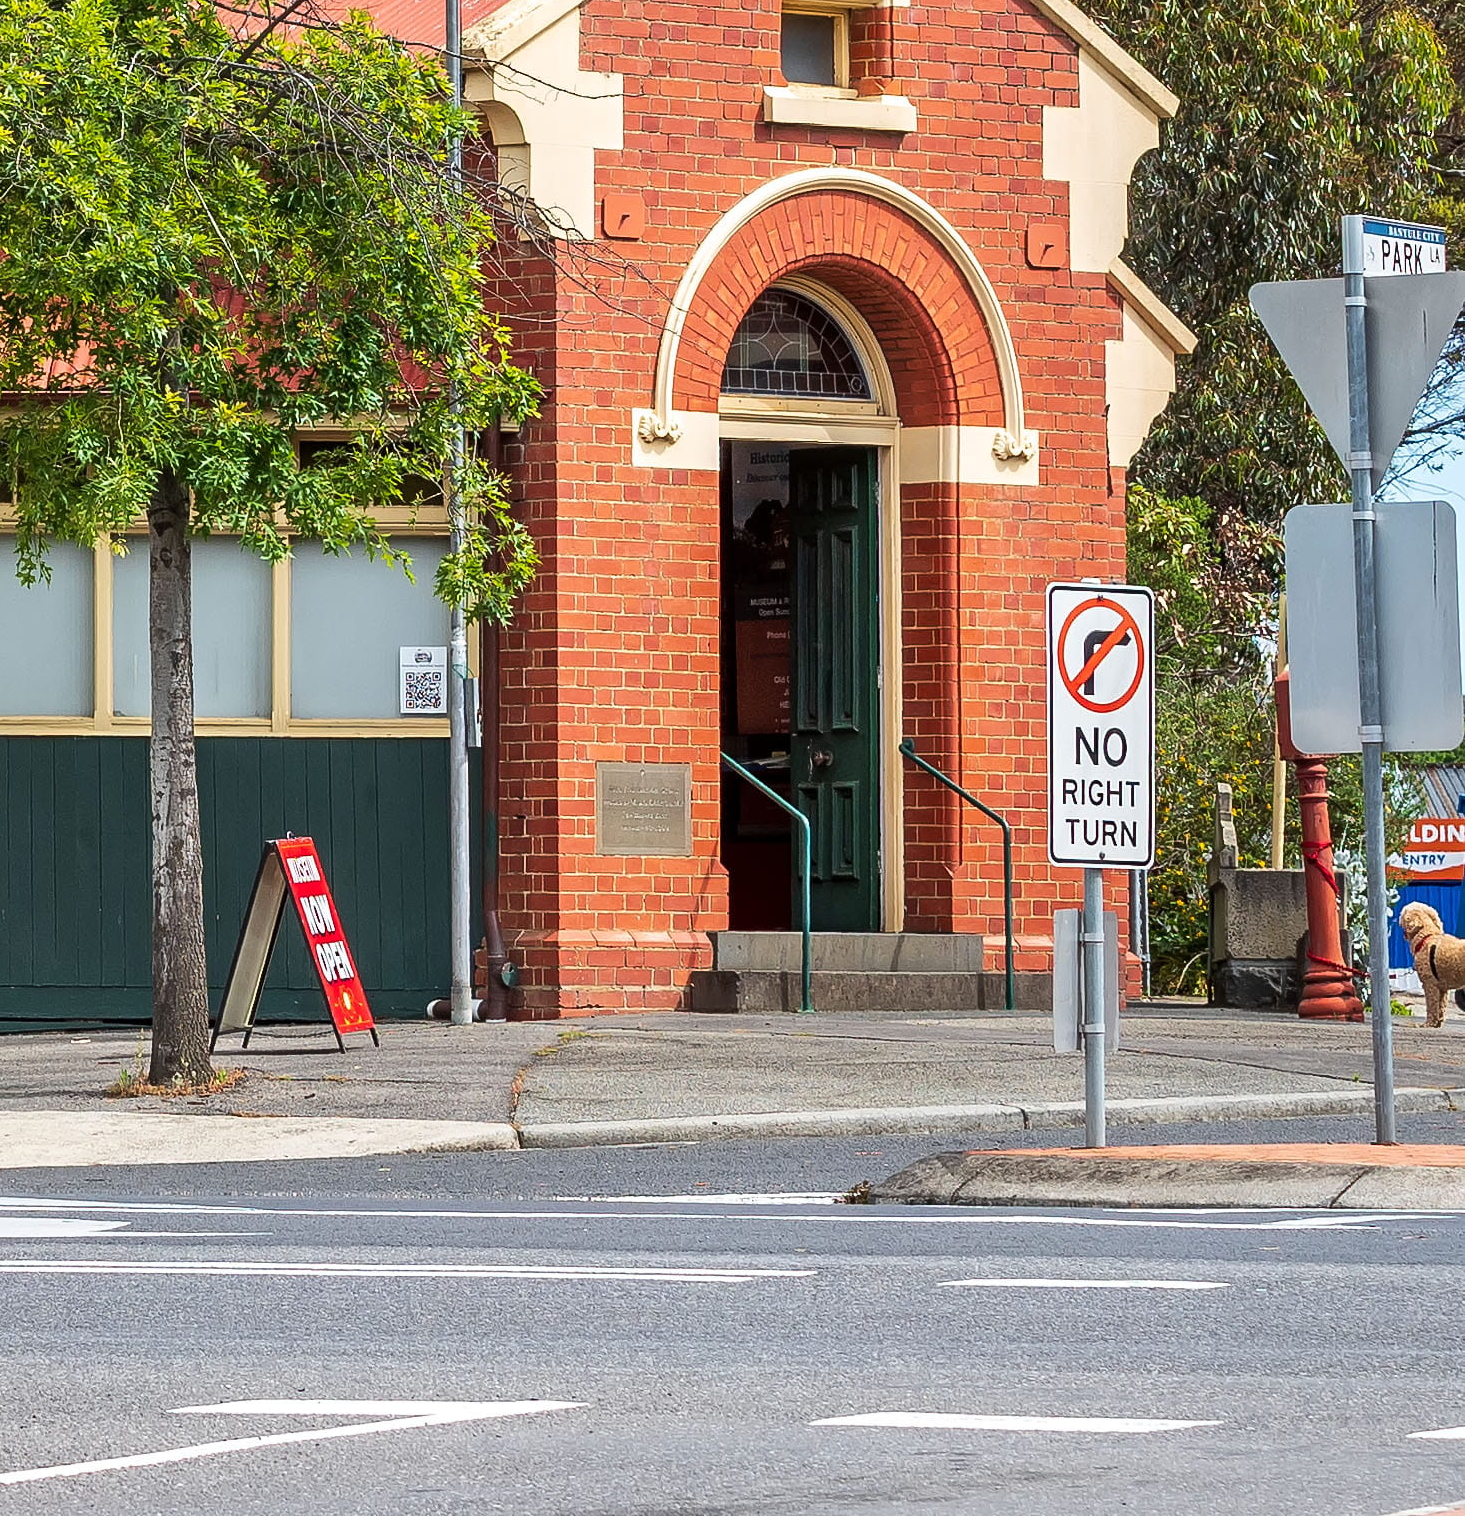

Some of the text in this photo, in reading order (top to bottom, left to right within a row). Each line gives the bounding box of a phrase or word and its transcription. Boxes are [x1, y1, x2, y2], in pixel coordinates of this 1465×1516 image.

[1423, 230, 1441, 243] CITY
[1382, 239, 1441, 275] PARK LA
[1075, 726, 1128, 767] NO
[1062, 778, 1140, 808] RIGHT
[1065, 818, 1137, 848] TURN
[1402, 823, 1465, 843] LDIN
[1402, 854, 1446, 865] ENTRY
[299, 894, 336, 936] NOW
[315, 940, 355, 983] OPEN
